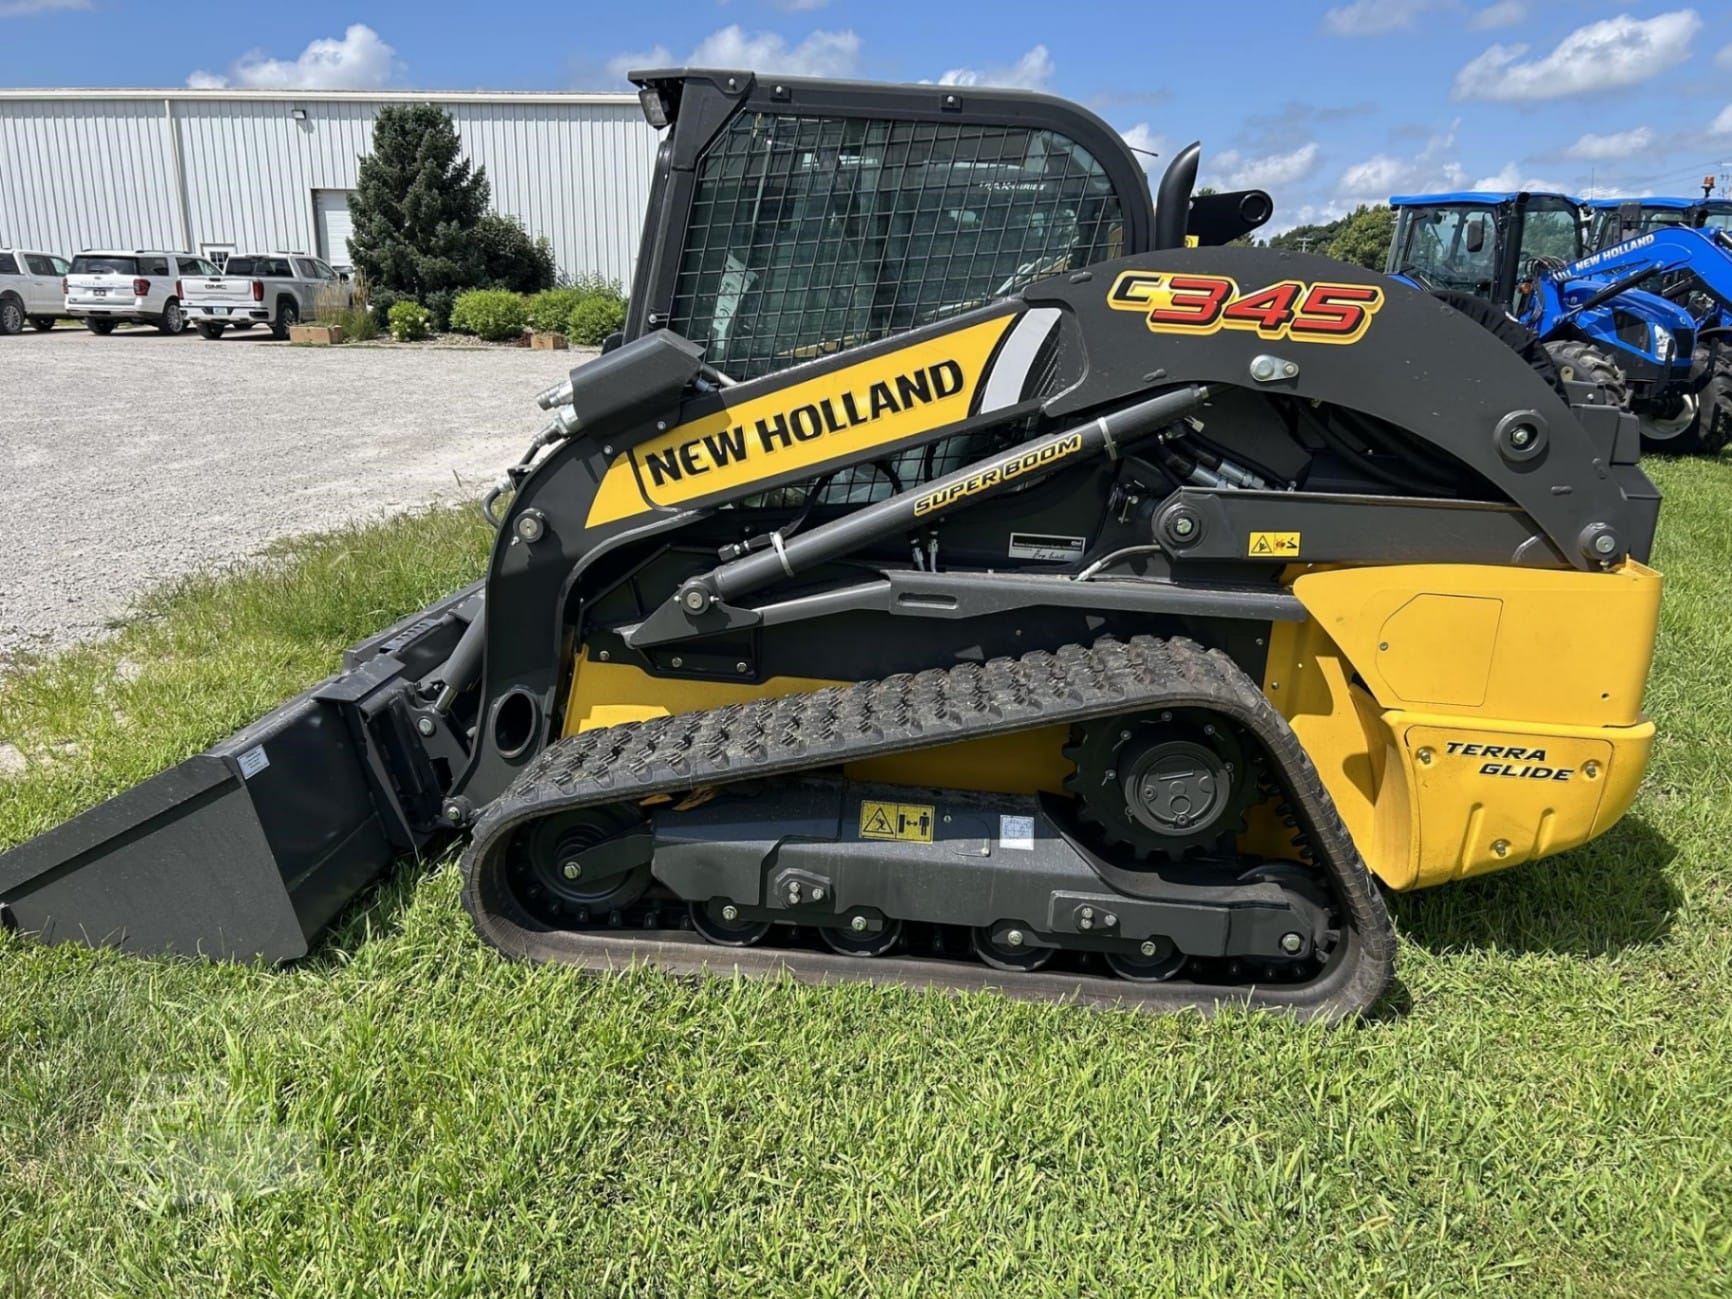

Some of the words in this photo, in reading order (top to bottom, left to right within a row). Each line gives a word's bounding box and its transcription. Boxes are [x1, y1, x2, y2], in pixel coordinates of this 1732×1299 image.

[1575, 254, 1600, 271] NEW
[1602, 234, 1655, 261] HOLLAND
[1112, 273, 1378, 335] C345
[645, 425, 746, 487] NEW
[754, 359, 964, 453] HOLLAND
[916, 470, 998, 514] SUPER
[1004, 436, 1079, 476] BOOM
[1447, 742, 1546, 761] TERRA
[1479, 763, 1574, 781] GLIDE
